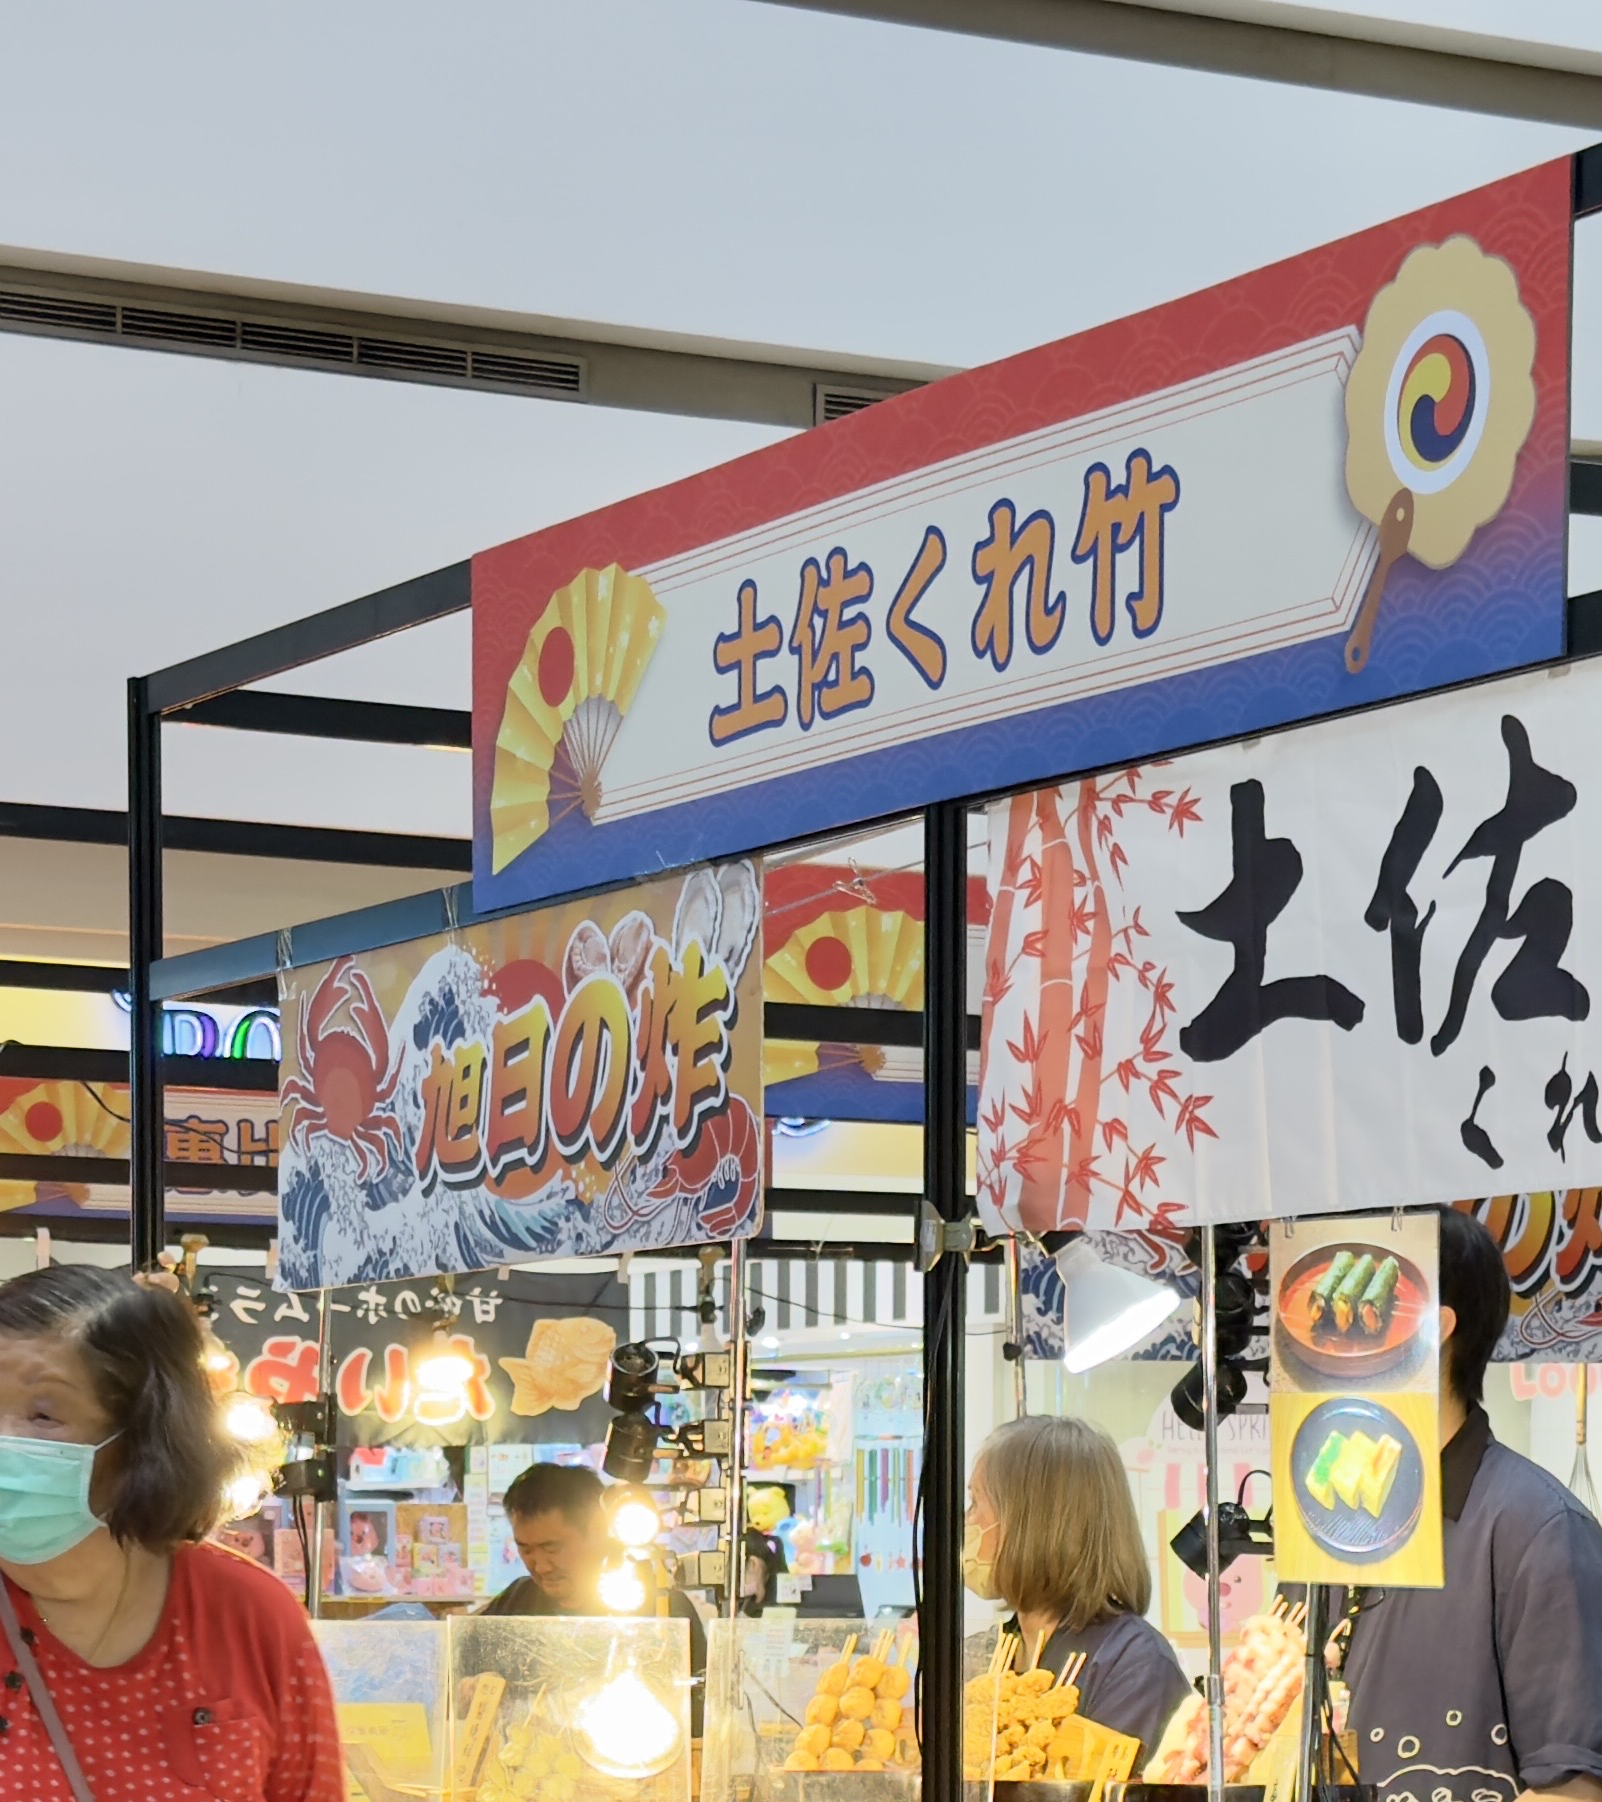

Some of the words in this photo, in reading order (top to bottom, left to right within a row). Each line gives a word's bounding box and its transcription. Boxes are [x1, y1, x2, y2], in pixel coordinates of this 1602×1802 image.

[708, 447, 1181, 748] 土佐くれ竹
[413, 939, 738, 1197] 旭日の炸
